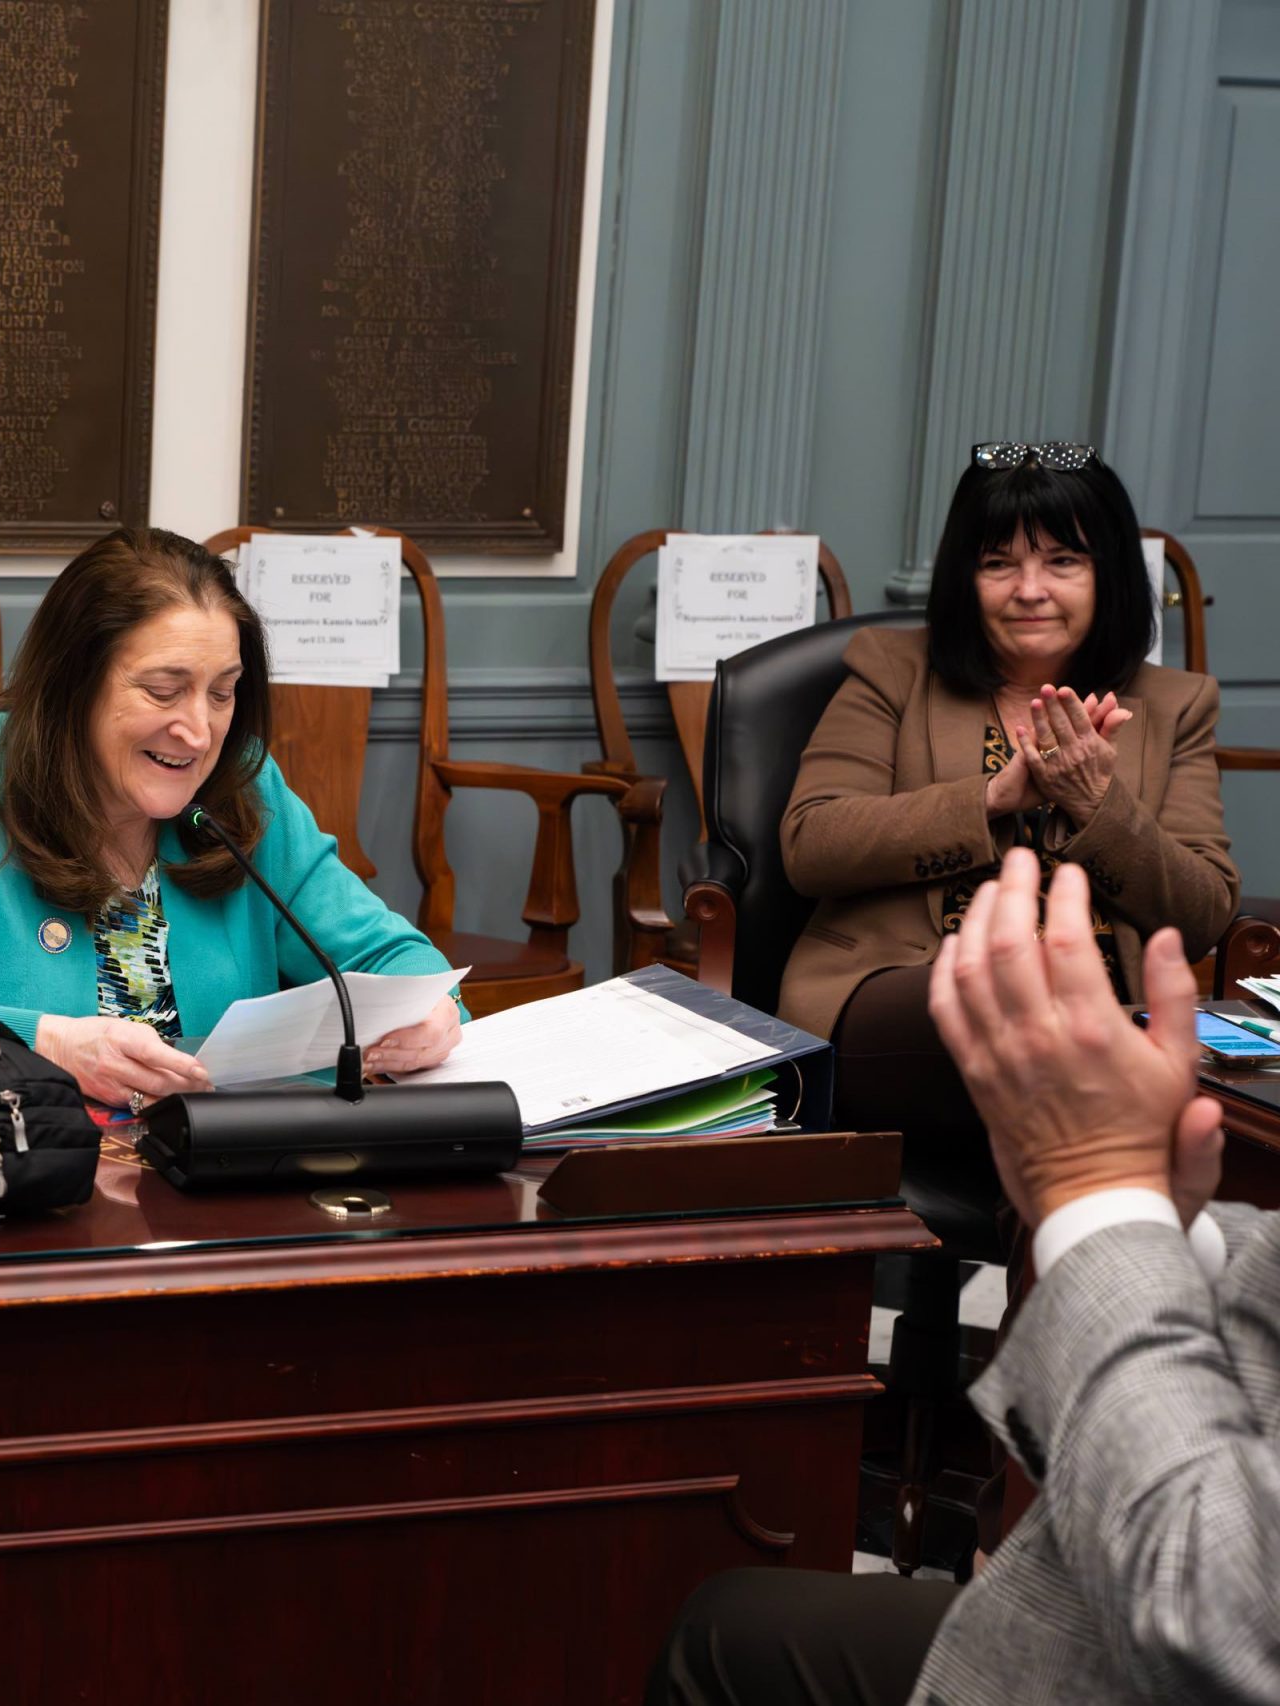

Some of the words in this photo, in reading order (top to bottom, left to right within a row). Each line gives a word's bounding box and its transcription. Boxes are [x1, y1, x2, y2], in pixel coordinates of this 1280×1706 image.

[0, 244, 44, 260] NEAL
[291, 574, 351, 585] RESERVED
[709, 572, 767, 583] RESERVED
[309, 592, 332, 603] FOR
[726, 589, 748, 600] FOR
